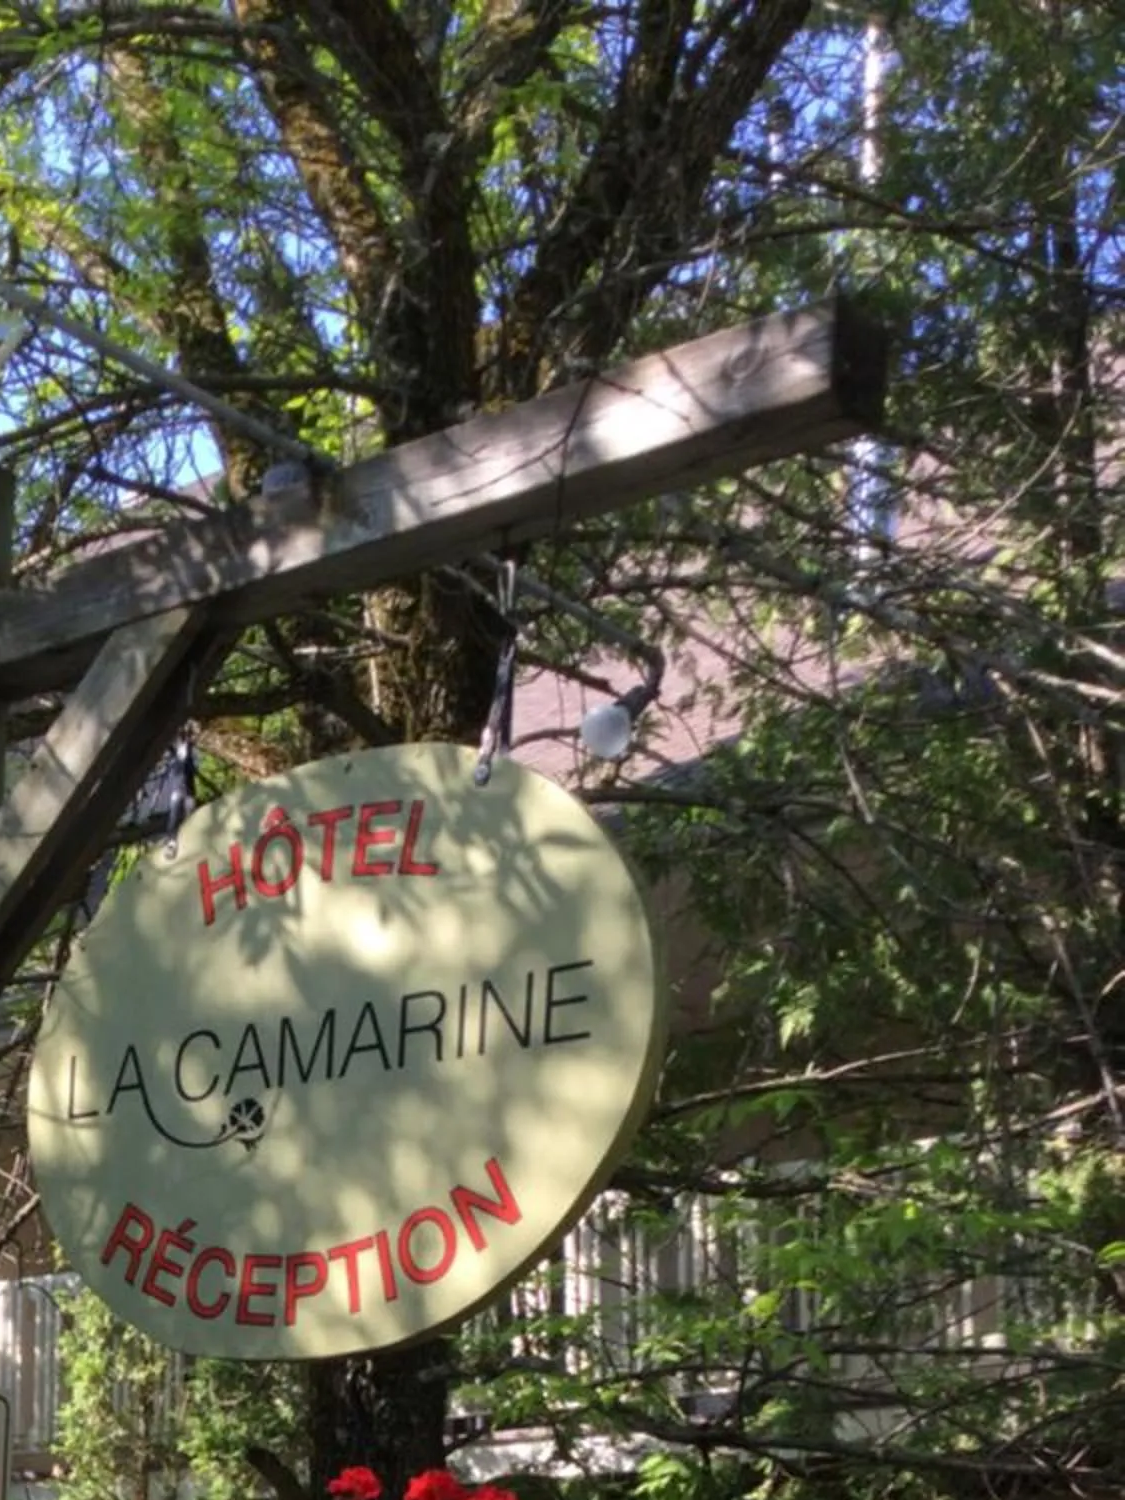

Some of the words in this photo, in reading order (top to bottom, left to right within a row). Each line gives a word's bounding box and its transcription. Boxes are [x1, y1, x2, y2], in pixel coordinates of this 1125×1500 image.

[198, 800, 439, 926] HÔTEL
[67, 1043, 178, 1136] LA
[174, 959, 595, 1102] CAMARINE
[101, 1157, 523, 1327] RÉCEPTION
